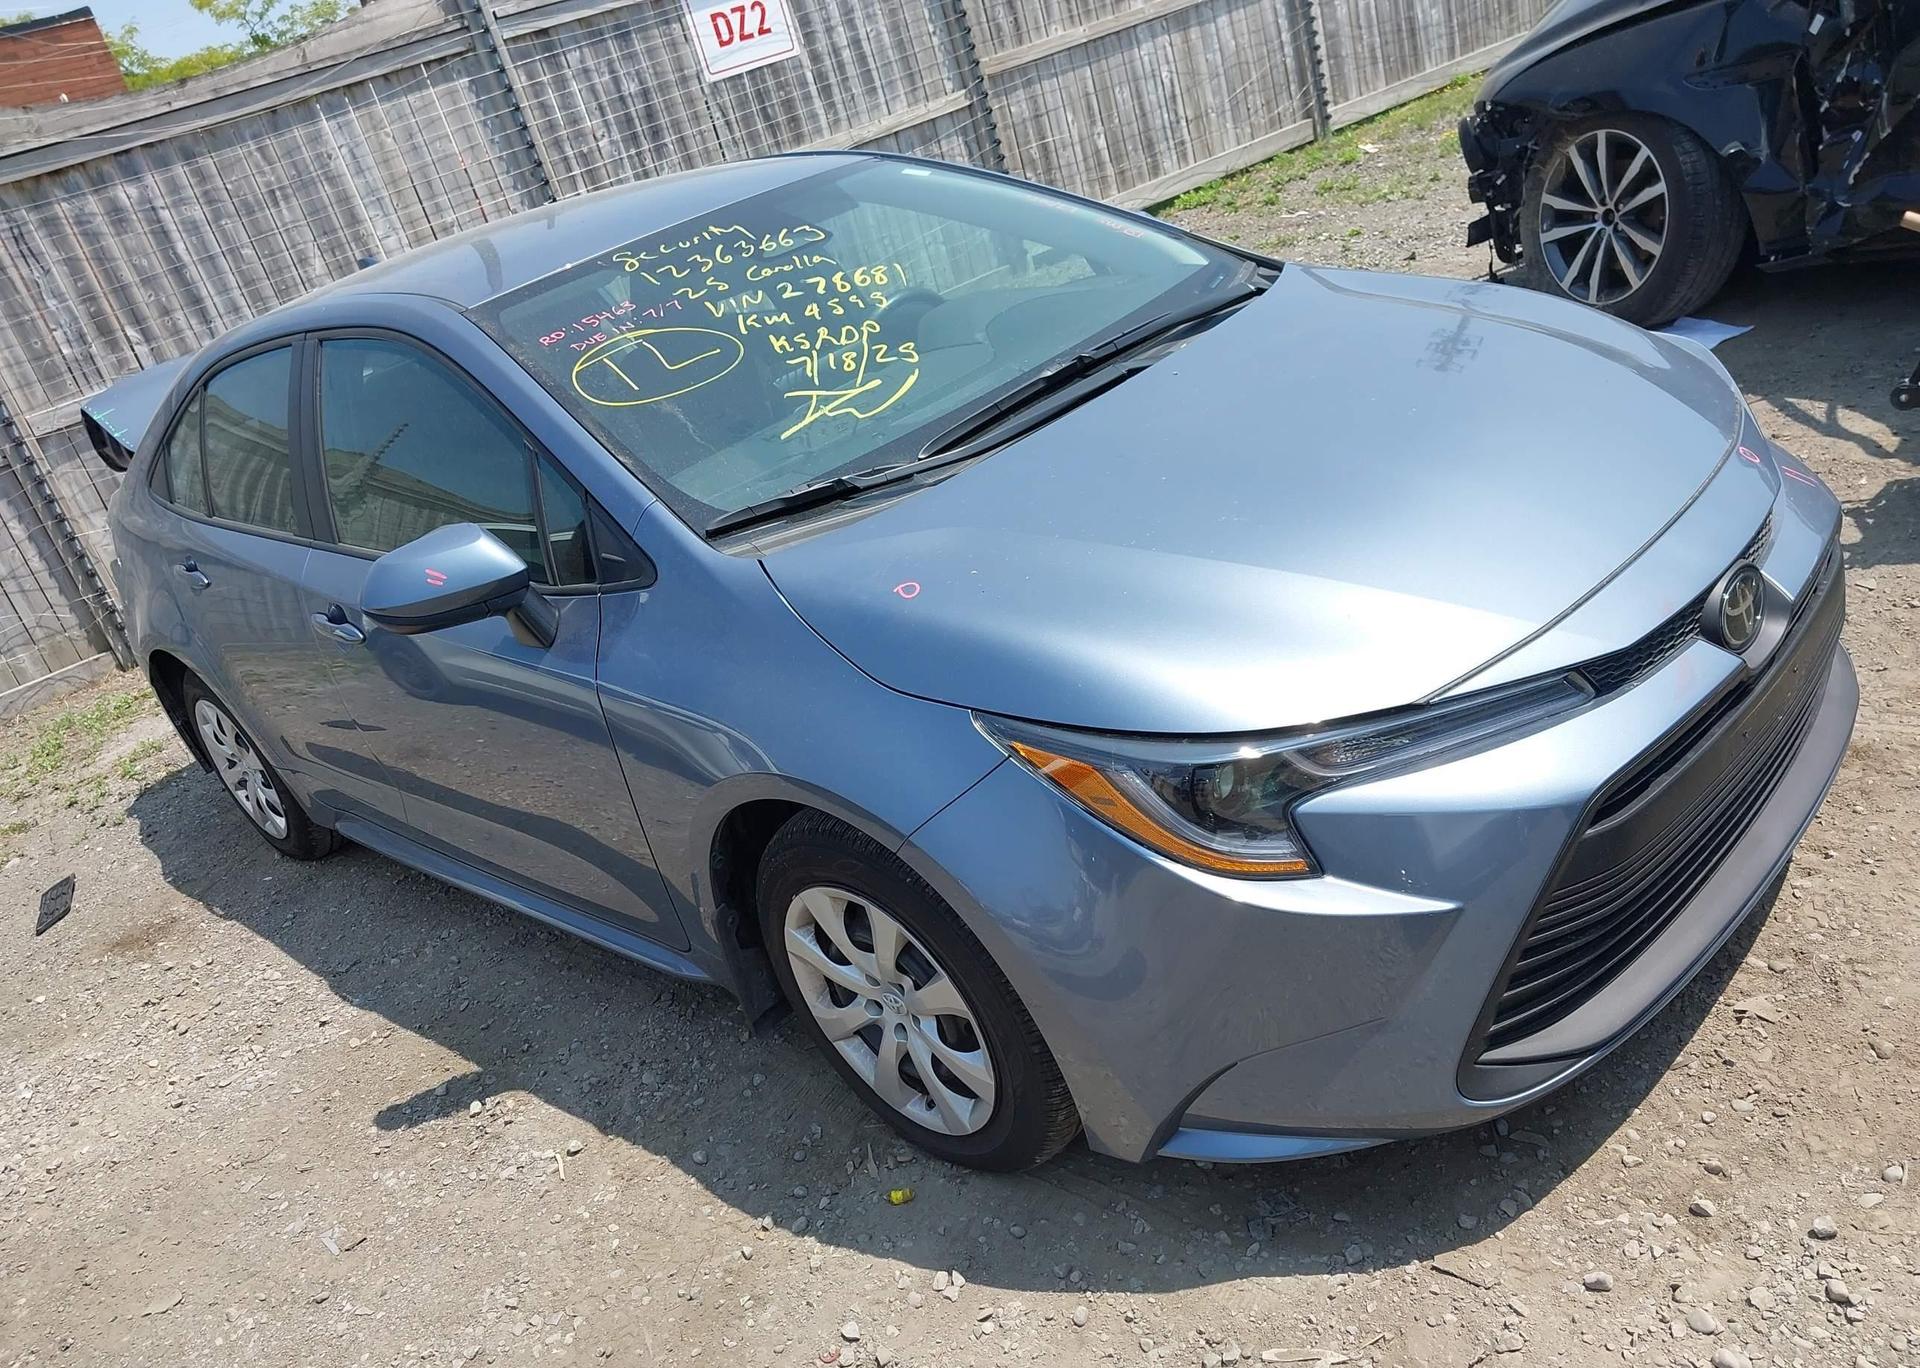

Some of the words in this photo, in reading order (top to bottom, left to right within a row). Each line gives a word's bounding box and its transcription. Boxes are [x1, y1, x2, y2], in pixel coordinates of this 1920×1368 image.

[710, 0, 772, 48] DZ2
[640, 224, 826, 285] 12363663
[704, 289, 763, 318] VIN
[776, 262, 907, 299] 278681
[570, 332, 607, 351] DUE
